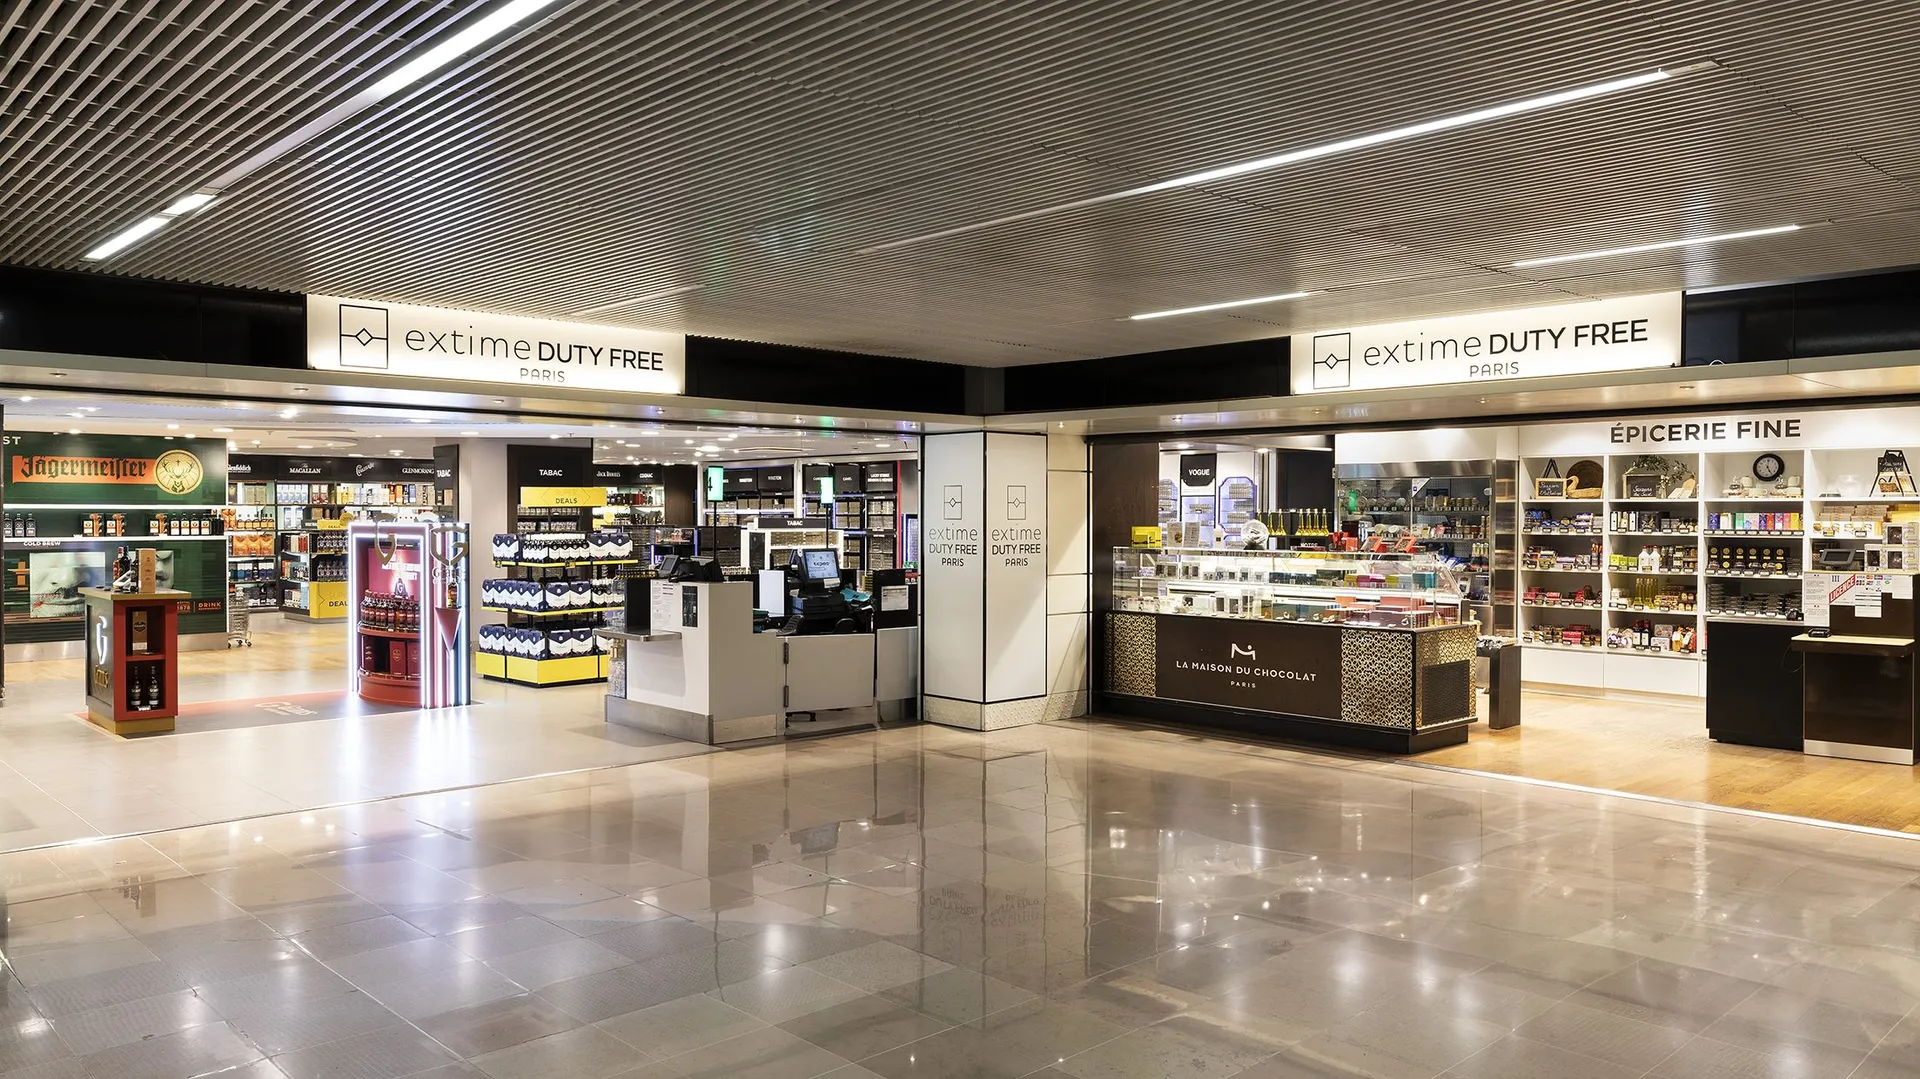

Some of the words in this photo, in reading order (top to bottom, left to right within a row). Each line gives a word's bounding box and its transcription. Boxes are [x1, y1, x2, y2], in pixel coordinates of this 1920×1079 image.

[405, 325, 531, 360] extime
[538, 341, 603, 366] DUTY
[610, 349, 663, 371] FREE
[1364, 332, 1481, 366] extime
[1489, 327, 1566, 354] DUTY
[1574, 318, 1648, 347] FREE
[520, 368, 565, 383] PARIS
[1469, 361, 1519, 377] PARIS
[1610, 422, 1726, 443] ÉPICERIE
[1738, 419, 1801, 439] FINE
[437, 469, 451, 477] TABAC
[539, 469, 563, 477] TABAC
[1188, 468, 1210, 476] VOGUE
[928, 523, 978, 541] extime
[992, 523, 1041, 541] extime
[929, 544, 954, 554] DUTY
[955, 544, 978, 555] FREE
[992, 544, 1018, 555] DUTY
[1019, 544, 1041, 554] FREE
[941, 557, 965, 567] PARIS
[1005, 558, 1029, 567] PARIS
[1829, 574, 1855, 601] LICENCE
[1176, 660, 1189, 669] LA
[1191, 662, 1232, 673] MAISON
[1236, 666, 1251, 675] DU
[1254, 668, 1317, 682] CHOCOLAT
